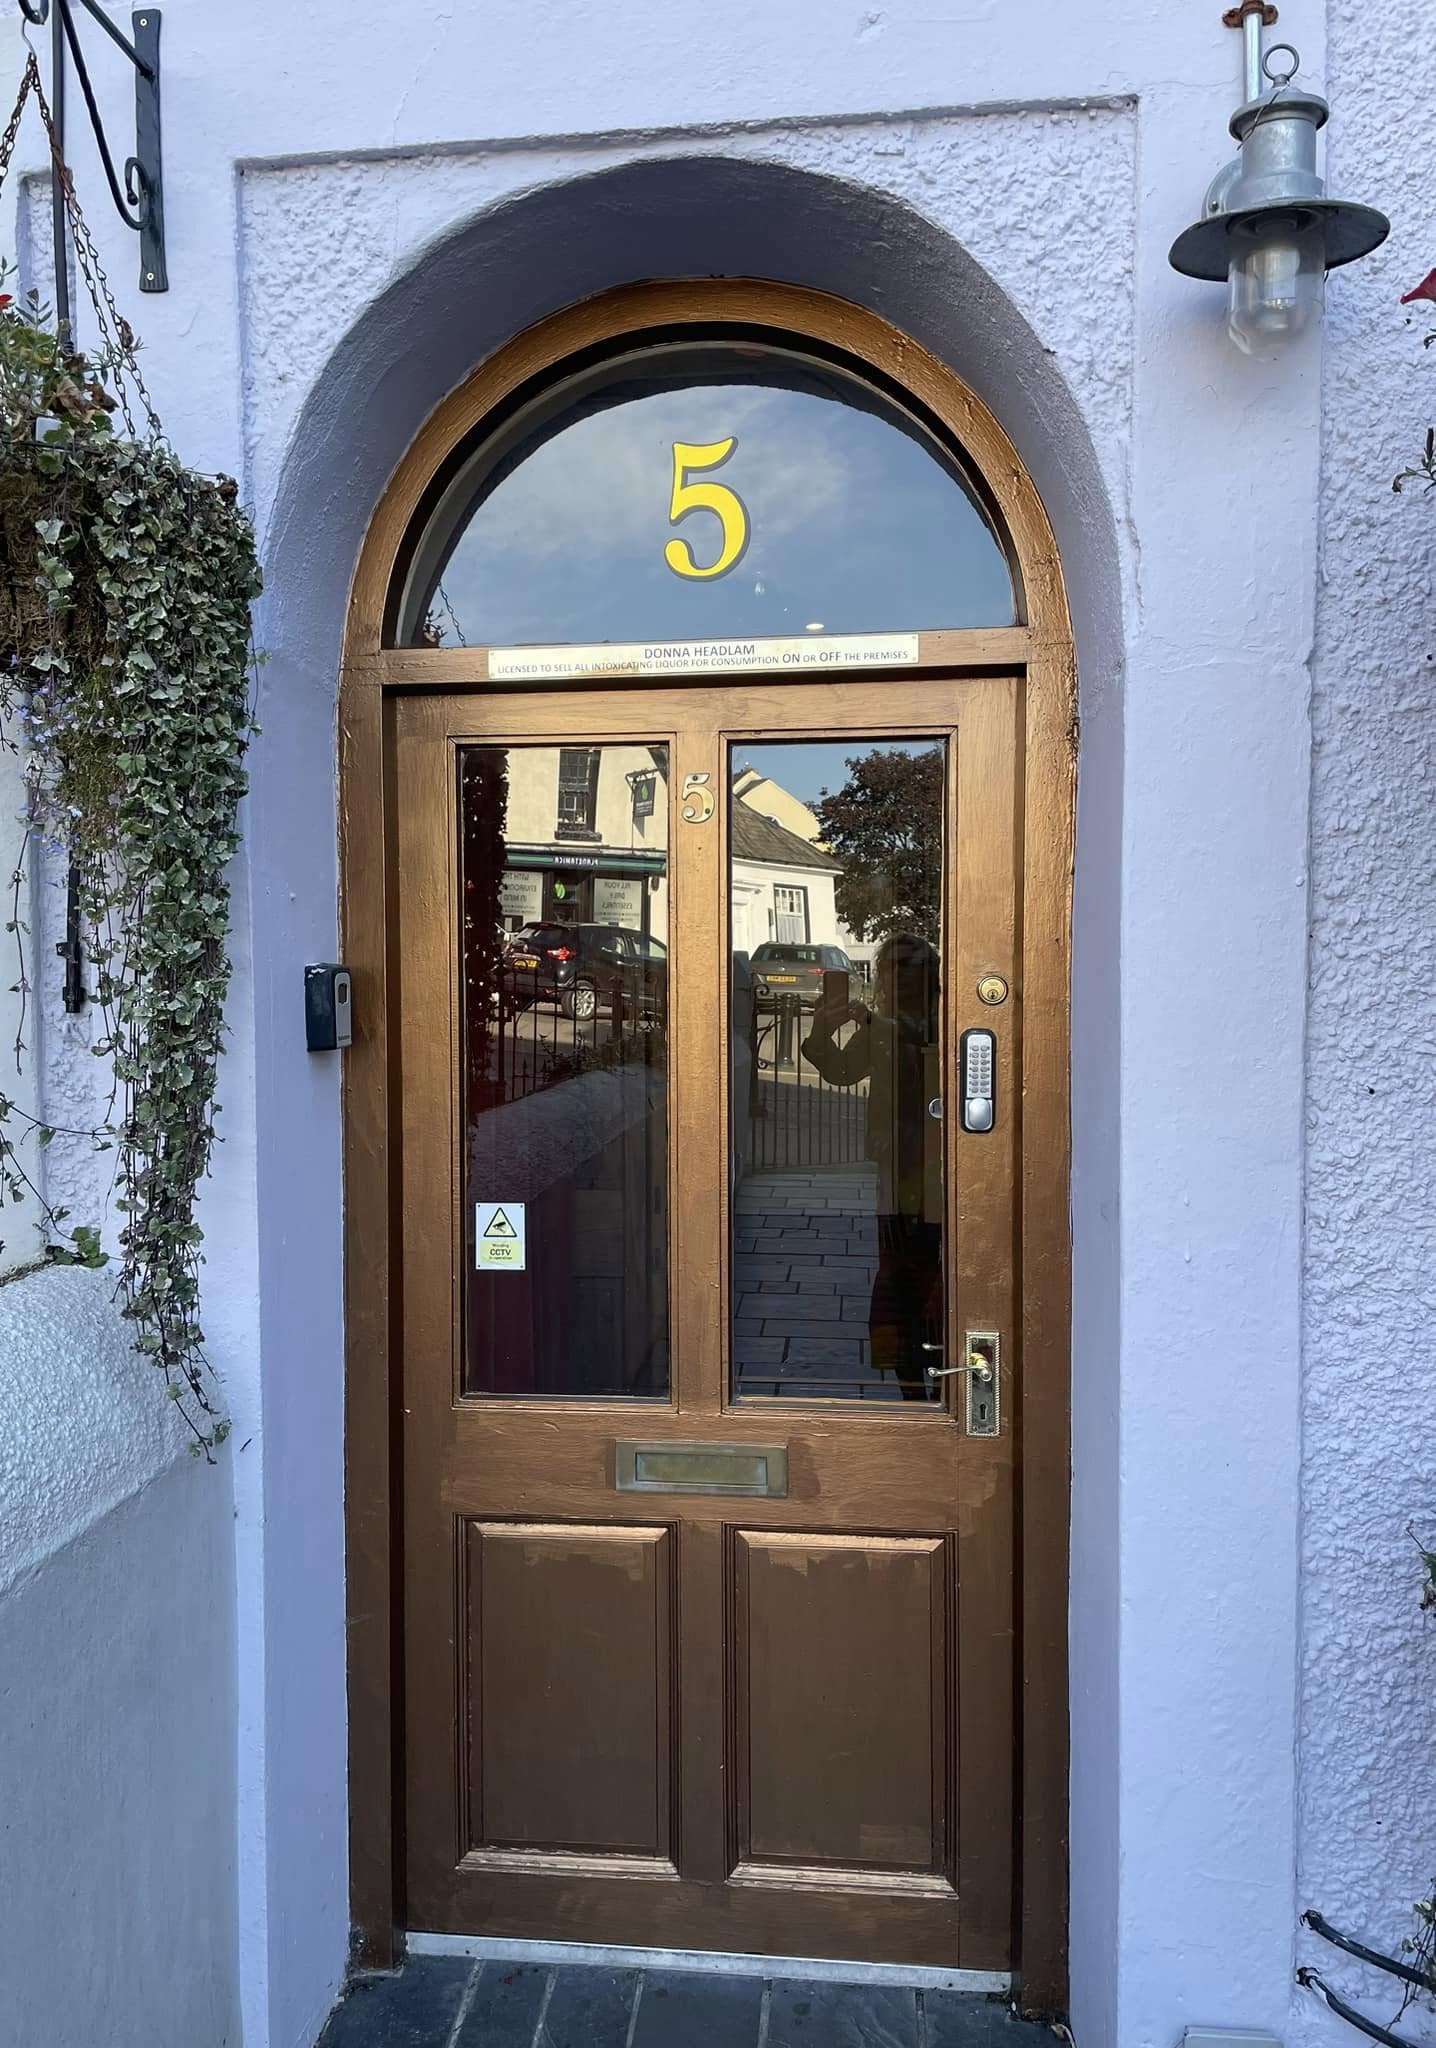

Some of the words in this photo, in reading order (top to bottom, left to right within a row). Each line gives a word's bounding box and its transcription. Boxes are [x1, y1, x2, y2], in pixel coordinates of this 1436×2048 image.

[664, 436, 751, 582] 5
[498, 664, 538, 674] LICENSED
[540, 664, 552, 673] TO
[554, 663, 572, 672] SELL
[574, 662, 589, 672] ALL
[591, 660, 653, 672] INTOXICATING
[655, 659, 689, 669] LIQUOR
[691, 658, 709, 668] FOR
[711, 655, 779, 667] CONSUMPTION
[782, 653, 800, 664] ON
[803, 655, 817, 663] OR
[819, 651, 842, 662] OFF
[844, 652, 861, 661] THE
[864, 650, 909, 660] PREMISES
[644, 647, 690, 659] DONNA
[694, 644, 755, 657] HEADLAM
[681, 773, 714, 823] 5
[490, 1248, 511, 1256] CCTV
